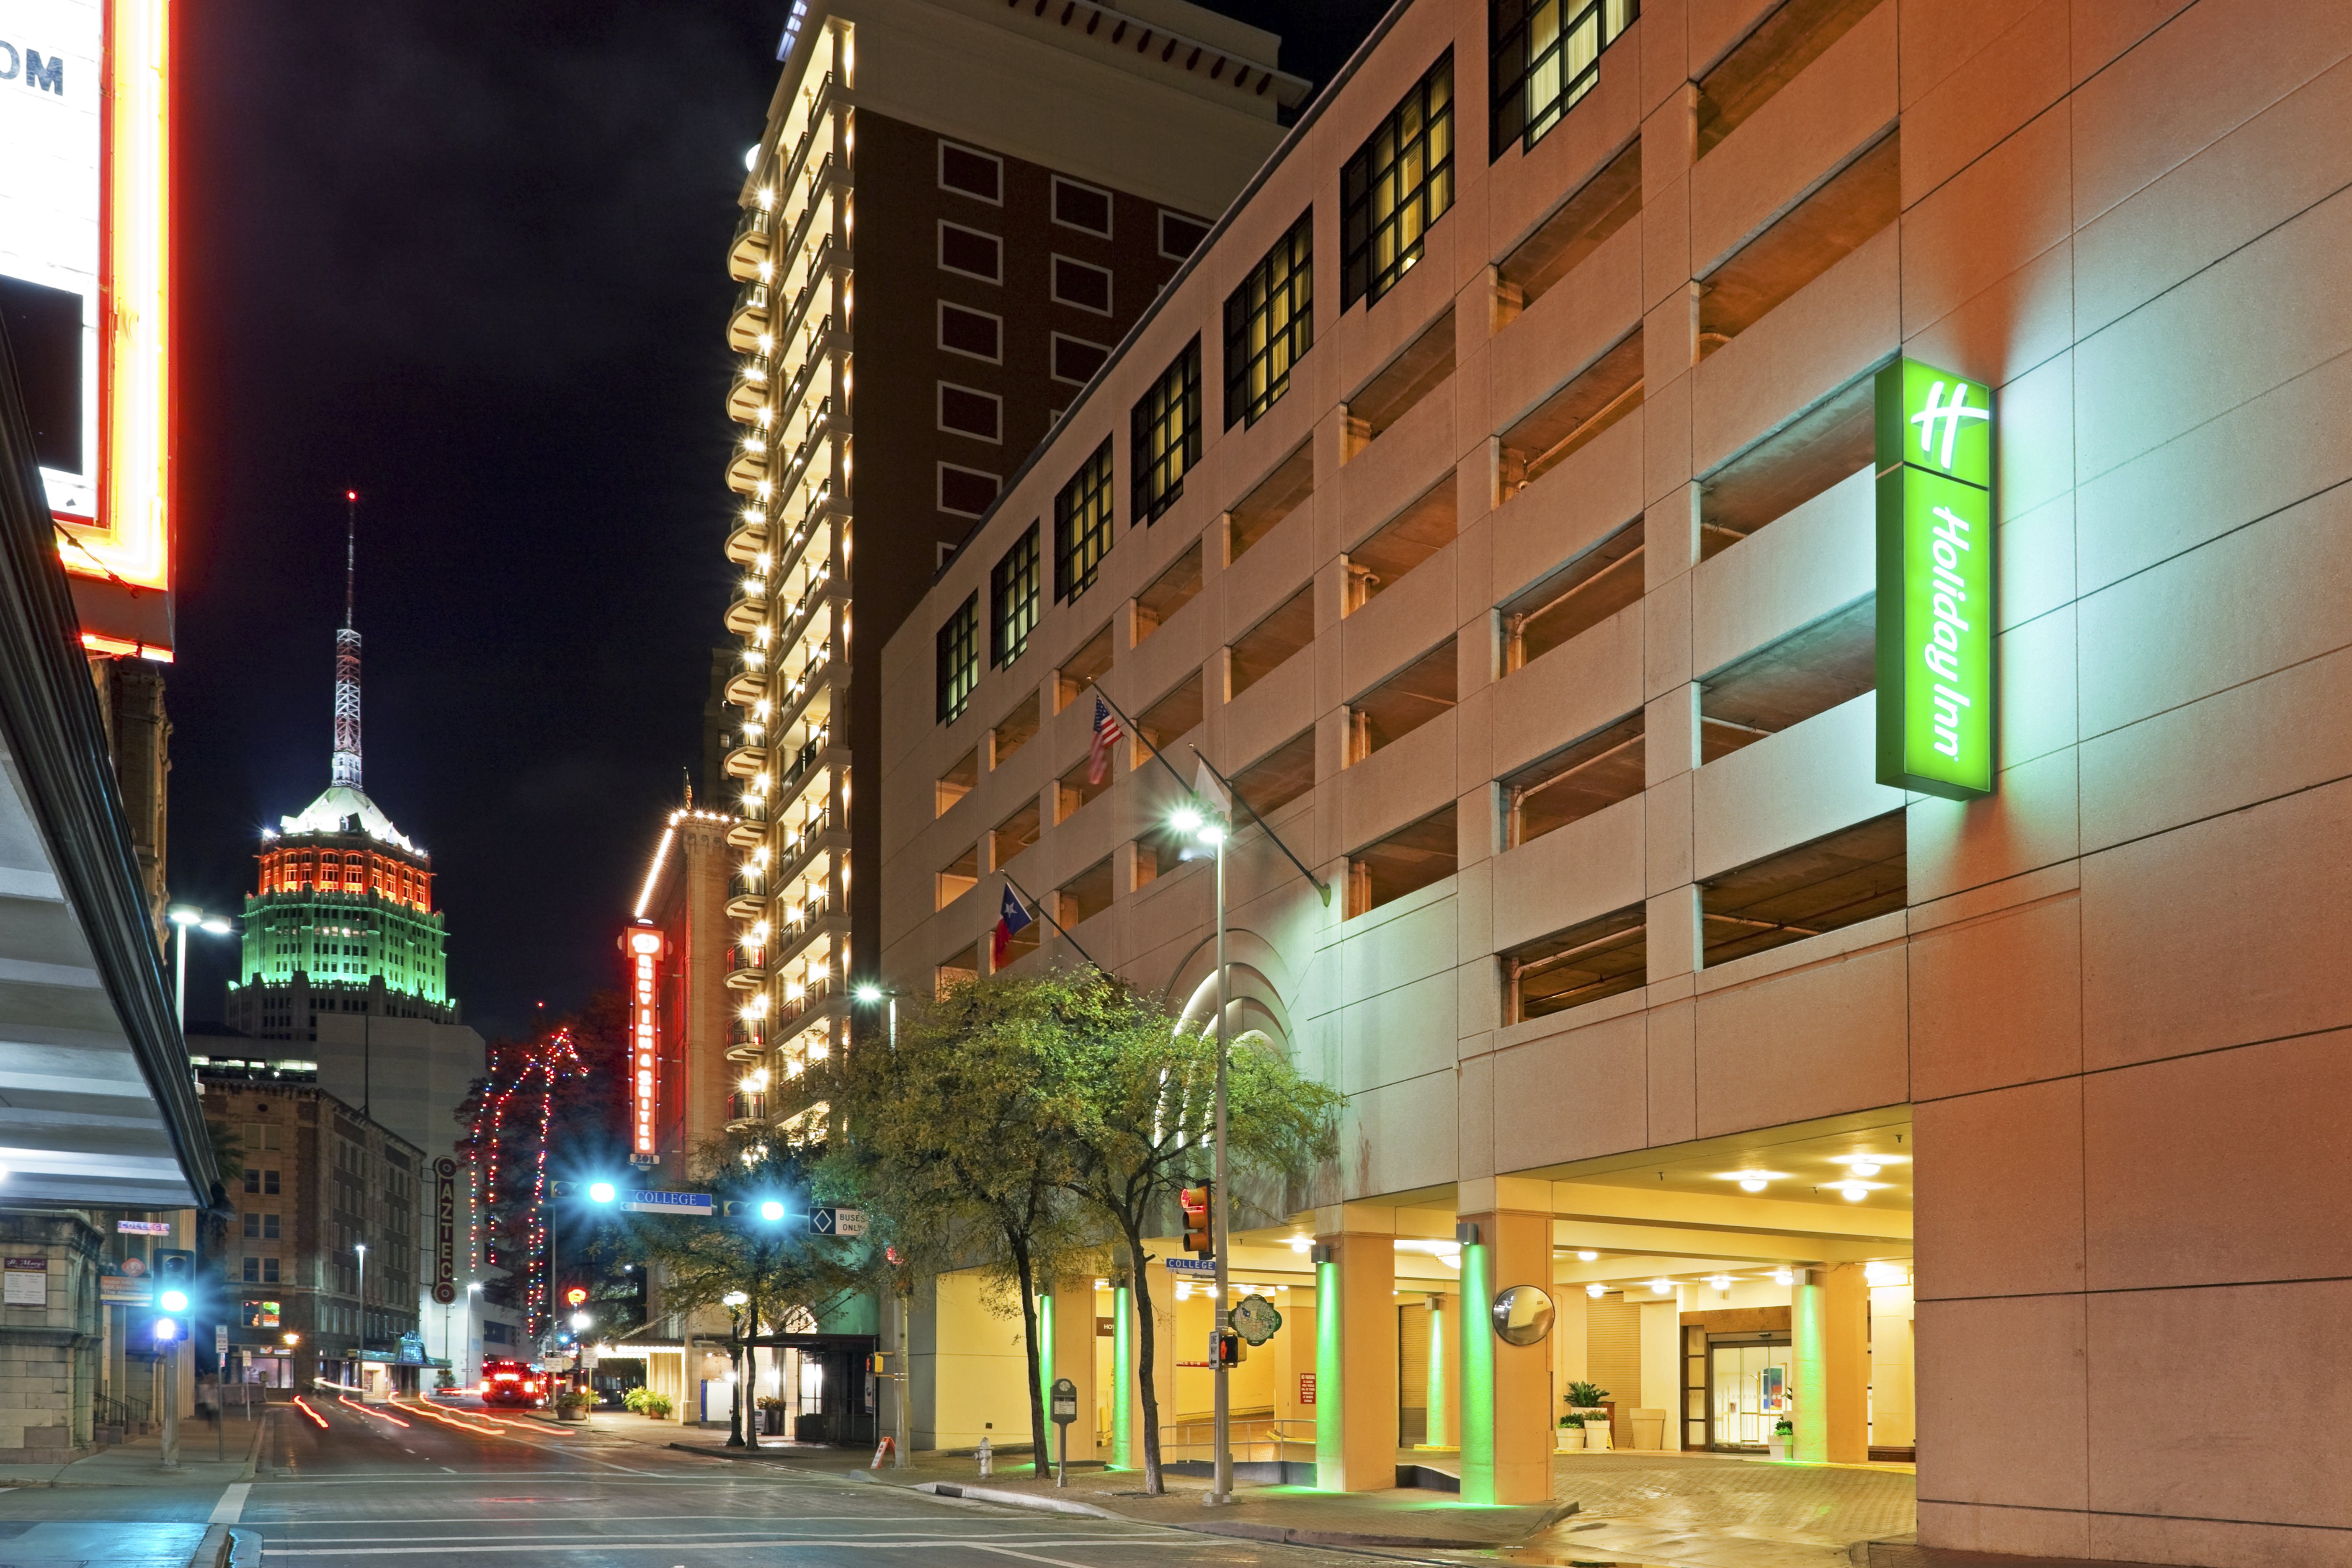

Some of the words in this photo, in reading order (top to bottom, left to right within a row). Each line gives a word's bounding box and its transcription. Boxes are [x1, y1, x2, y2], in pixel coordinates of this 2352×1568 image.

[1924, 506, 1969, 683] Holiday
[1934, 683, 1970, 756] Inn
[638, 1009, 652, 1049] INN
[638, 1070, 652, 1150] SUITES
[635, 1191, 697, 1205] COLLEGE
[840, 1214, 865, 1222] BUSES
[121, 1222, 167, 1231] COLLEGE
[441, 1183, 452, 1279] AZTEC
[1169, 1259, 1213, 1269] COLLEGE
